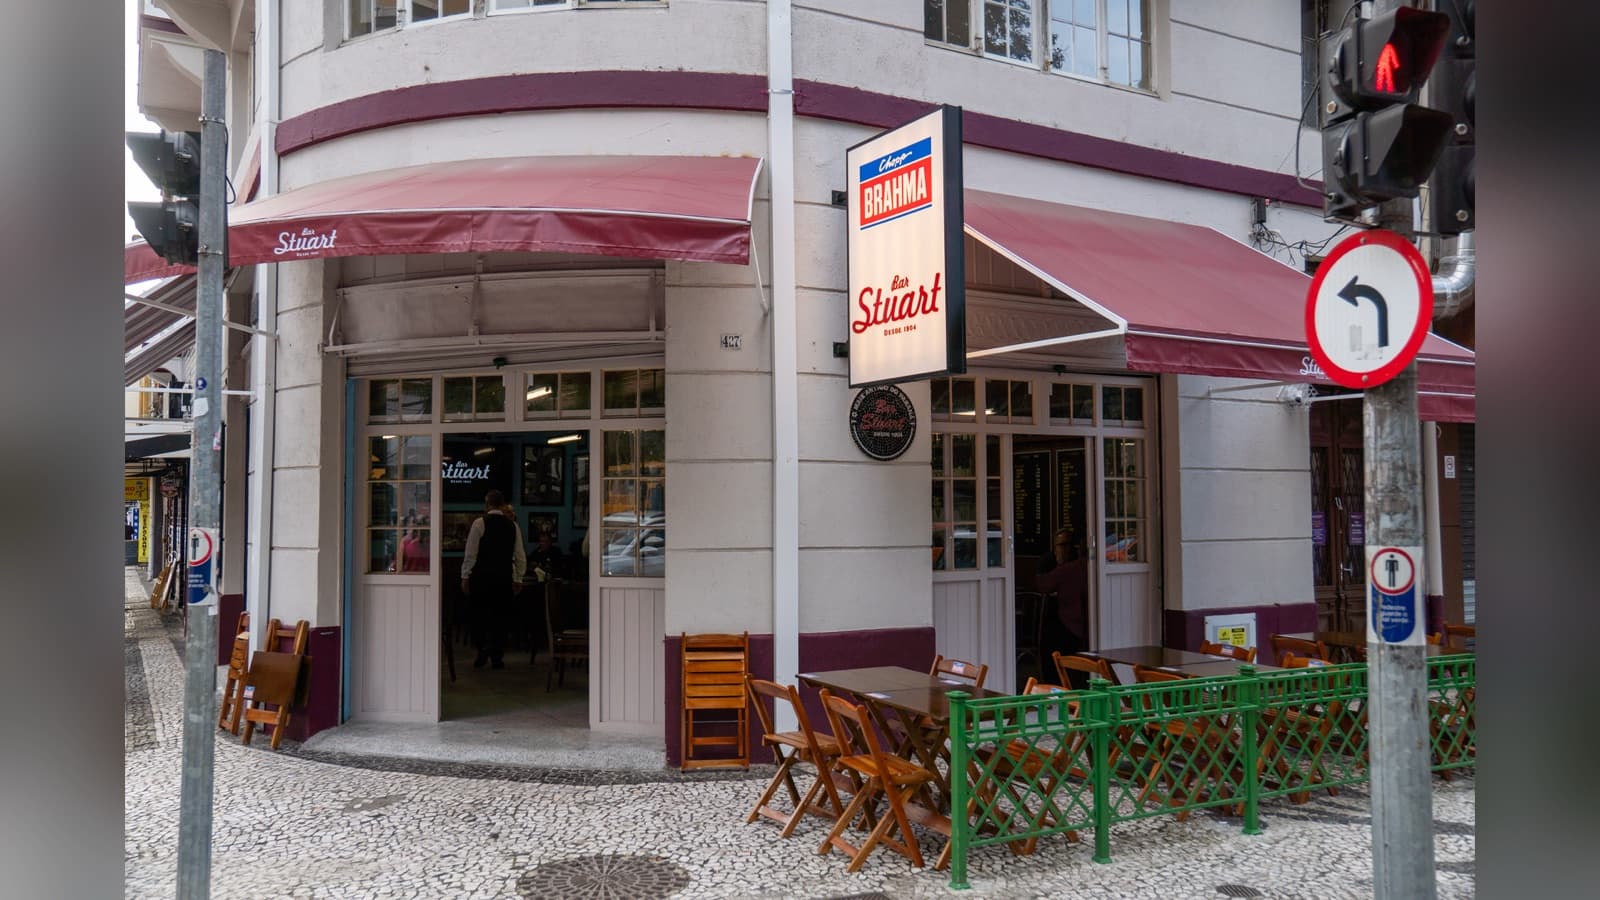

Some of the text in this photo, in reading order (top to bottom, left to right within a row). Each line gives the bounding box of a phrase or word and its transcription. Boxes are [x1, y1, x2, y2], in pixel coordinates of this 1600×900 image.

[878, 151, 912, 173] Chopp
[864, 166, 927, 219] BRAHMA
[273, 229, 337, 255] Stuart
[891, 274, 909, 292] Bar
[852, 272, 942, 335] Stuart
[721, 335, 739, 348] 427
